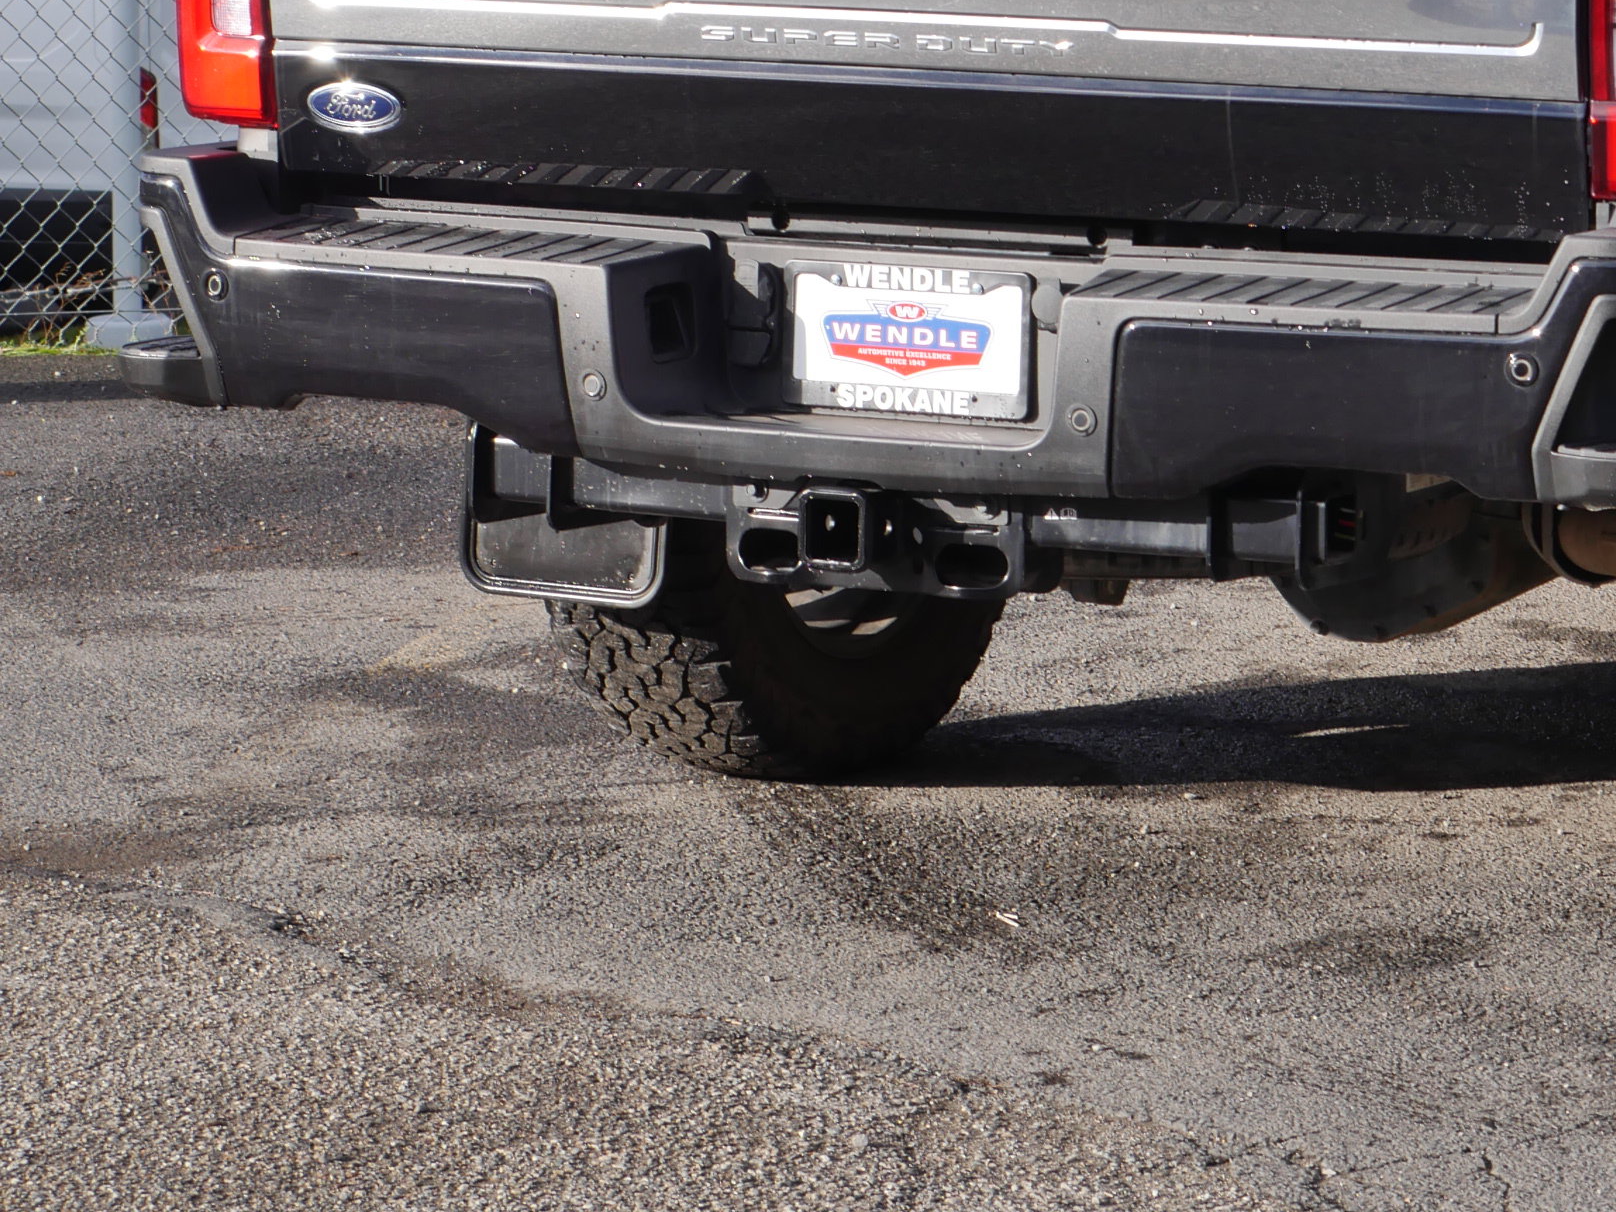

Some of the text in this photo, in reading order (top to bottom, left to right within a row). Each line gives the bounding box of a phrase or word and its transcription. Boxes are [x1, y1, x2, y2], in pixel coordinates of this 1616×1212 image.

[701, 25, 1076, 58] SUPER DUTY
[326, 91, 376, 119] Ford
[843, 263, 971, 293] WENDLE
[895, 305, 920, 319] W
[832, 321, 978, 349] WENDLE
[858, 347, 952, 360] AUTOMOTIVE EXCELLENCE
[885, 357, 907, 366] SINCE
[836, 383, 971, 415] SPOKANE
